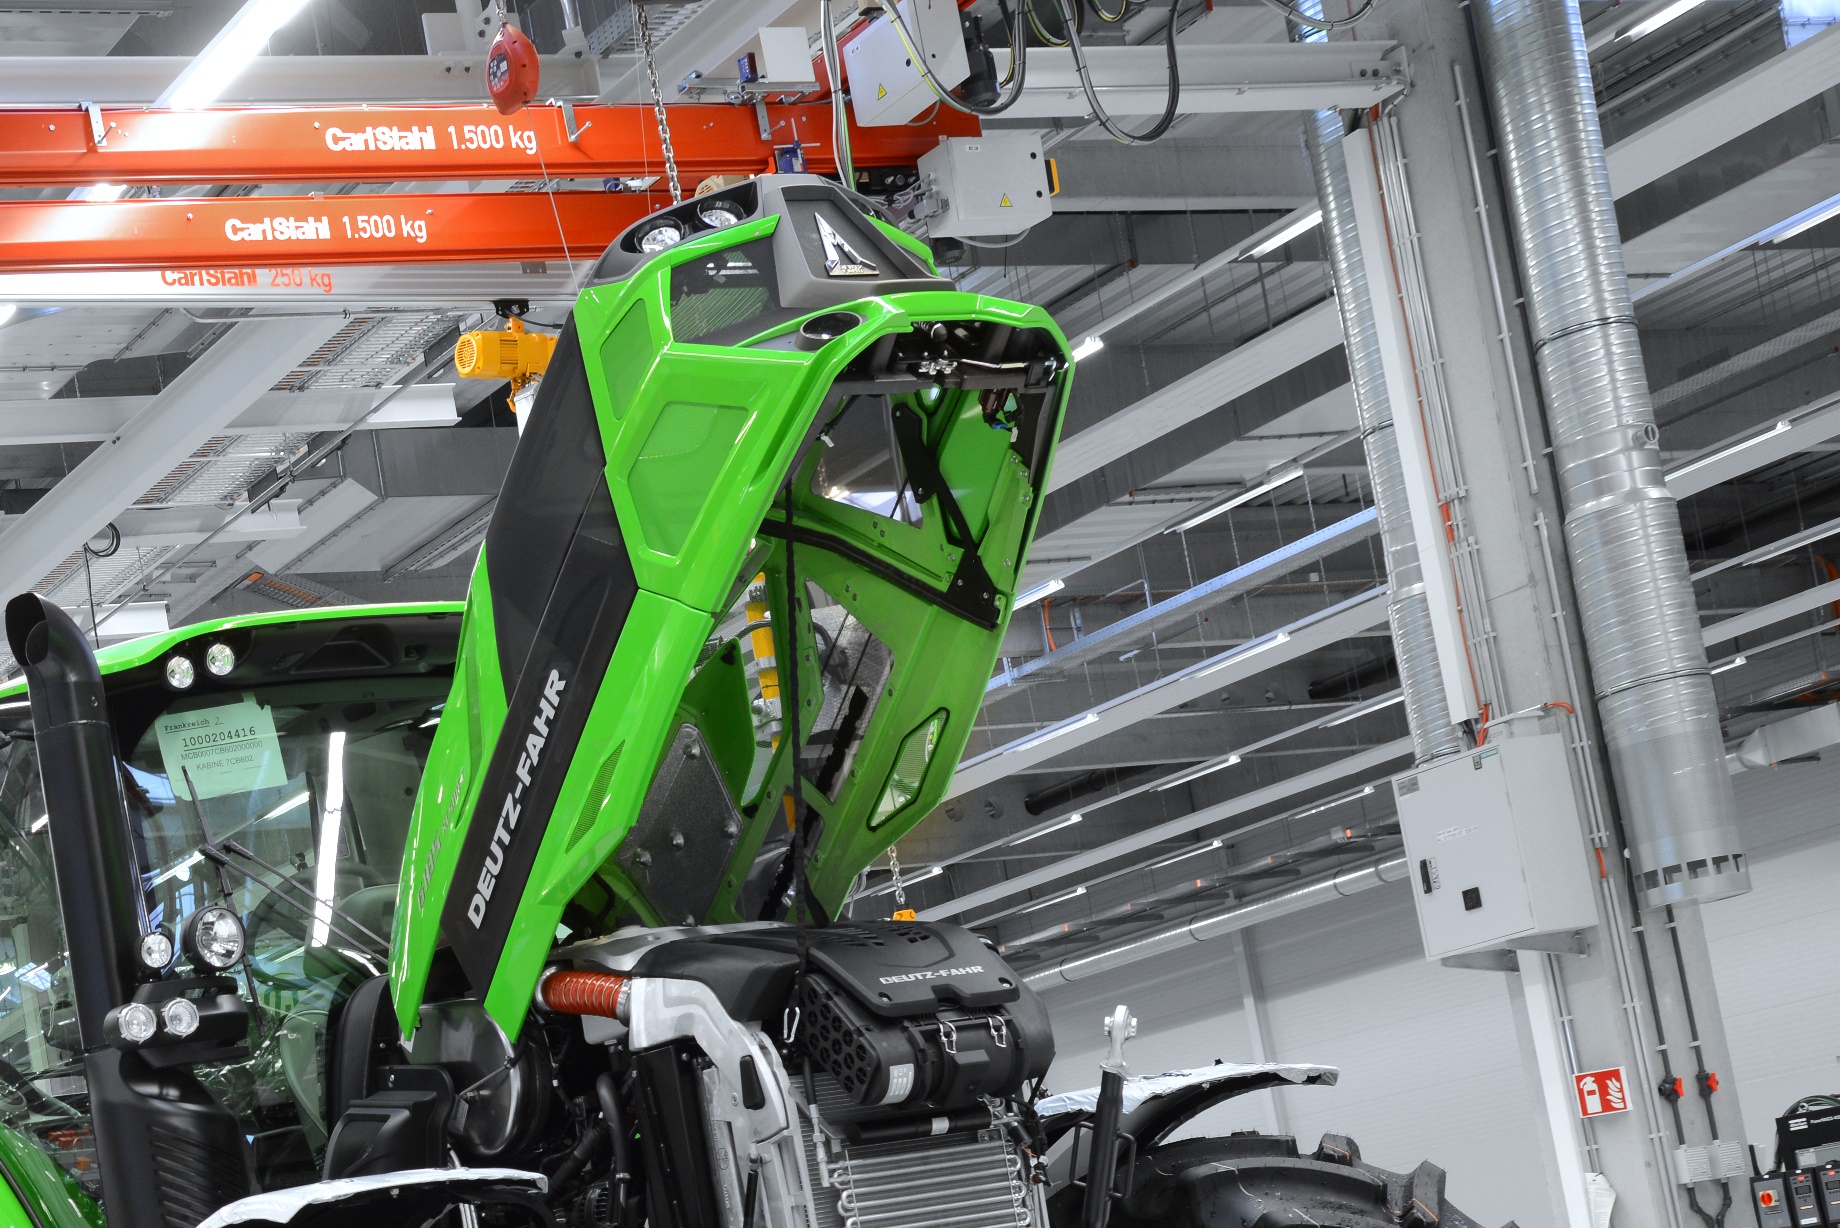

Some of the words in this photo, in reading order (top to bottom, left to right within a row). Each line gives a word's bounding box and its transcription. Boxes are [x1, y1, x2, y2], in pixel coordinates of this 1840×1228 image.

[447, 124, 504, 151] 1.500
[509, 124, 537, 155] kg
[342, 214, 396, 240] 1.500
[400, 213, 428, 244] kg
[270, 267, 304, 289] 250
[309, 268, 333, 293] kg
[163, 718, 210, 732] Frankreich
[181, 725, 257, 748] 1000204416
[196, 759, 225, 771] KABINE
[226, 754, 254, 766] 7CB602
[467, 669, 567, 930] DEUTZ-FAHR
[879, 965, 985, 985] DEUTZ-FAHR
